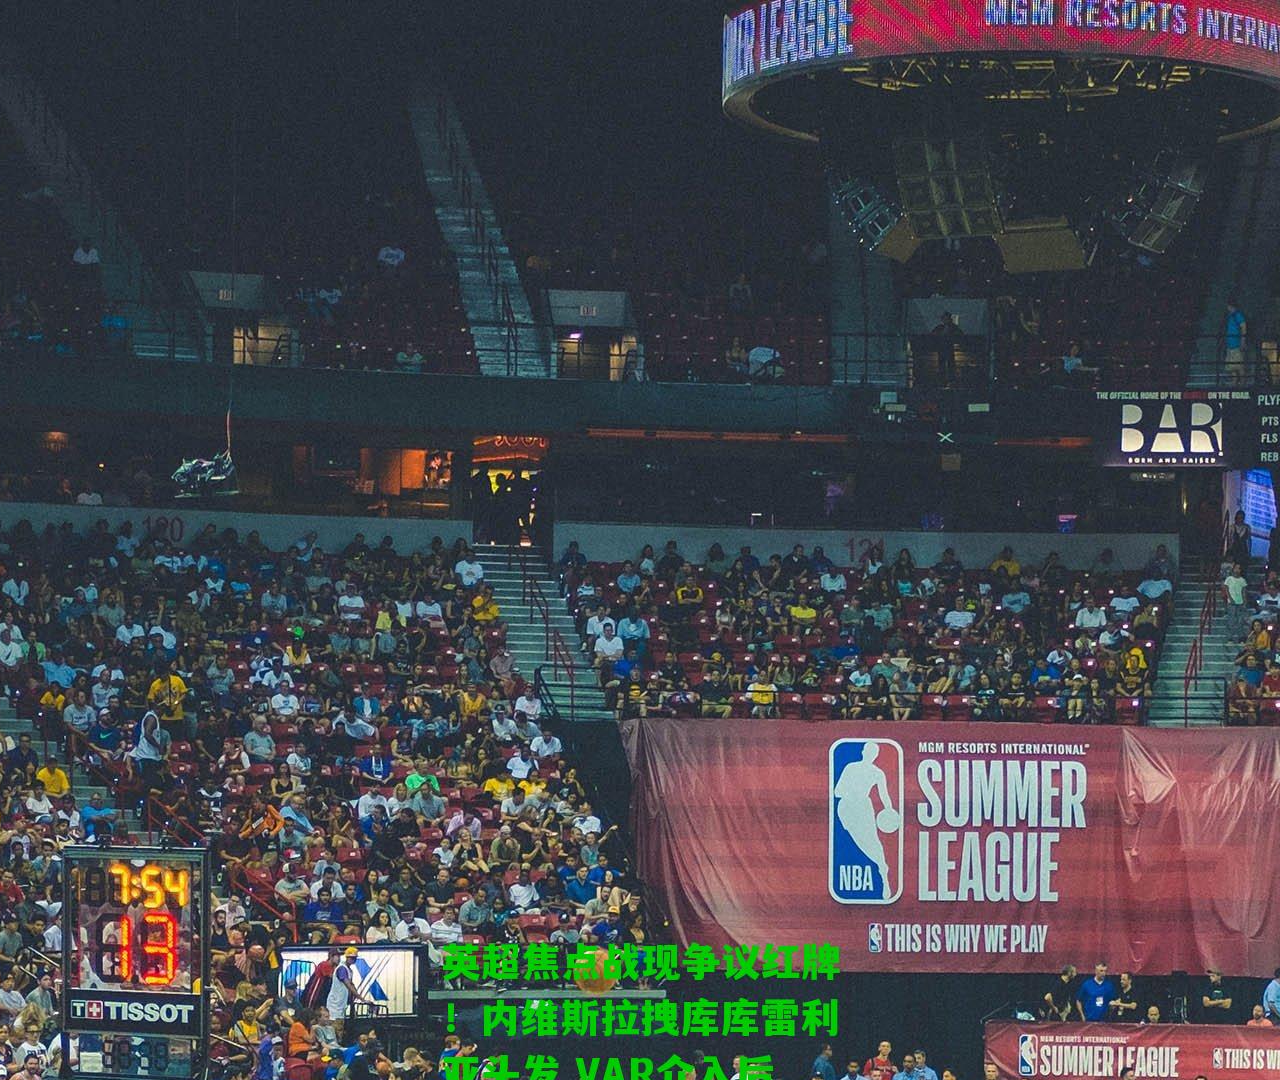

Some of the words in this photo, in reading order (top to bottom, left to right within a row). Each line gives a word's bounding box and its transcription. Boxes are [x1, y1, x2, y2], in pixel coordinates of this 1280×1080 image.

[1065, 0, 1188, 35] RESORTS
[759, 0, 850, 71] LEAGUE
[1261, 416, 1280, 426] PTS
[1260, 433, 1278, 444] FLS
[1260, 452, 1279, 462] REB
[918, 742, 945, 754] MGM
[948, 743, 997, 754] RESORTS
[1000, 743, 1088, 755] INTERNATIONAL
[916, 758, 1088, 829] SUMMER
[839, 865, 873, 892] NBA
[917, 831, 1060, 903] LEAGUE
[109, 865, 190, 909] 7:54
[119, 914, 178, 985] 13
[885, 924, 922, 953] THIS
[925, 924, 942, 953] IS
[944, 924, 980, 953] WHY
[983, 924, 1008, 953] WE
[1010, 924, 1048, 953] PLAY
[104, 1001, 194, 1023] TISSOT
[1039, 1045, 1114, 1077] SUMMER
[1224, 1049, 1251, 1070] THIS
[1252, 1049, 1264, 1070] IS
